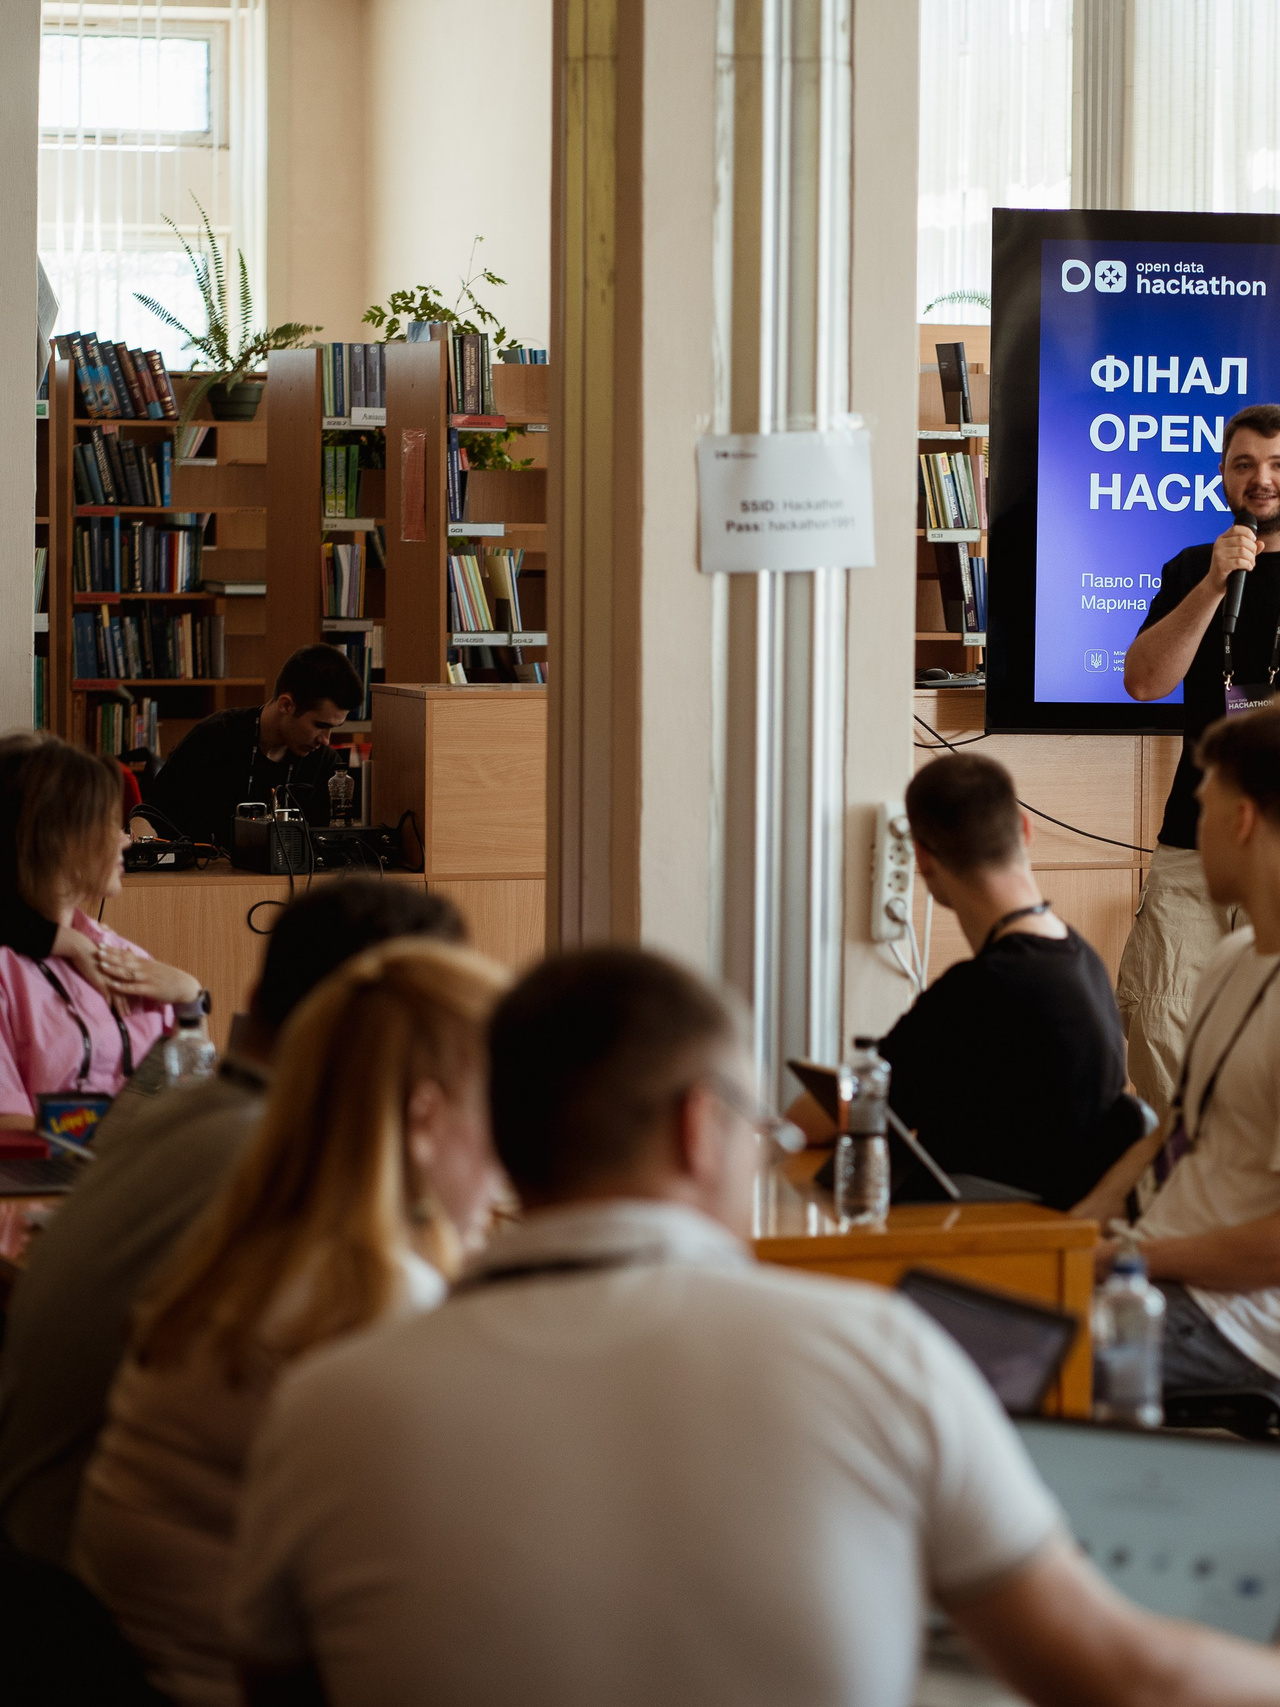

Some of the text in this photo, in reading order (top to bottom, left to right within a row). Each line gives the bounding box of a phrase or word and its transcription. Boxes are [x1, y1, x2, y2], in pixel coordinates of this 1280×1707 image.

[1136, 261, 1204, 274] open data
[1136, 274, 1267, 296] hackathon
[1090, 355, 1248, 395] ФІНАЛ
[1089, 413, 1225, 453] OPEN
[1081, 573, 1134, 588] Павло
[1139, 573, 1162, 589] По
[1081, 595, 1147, 614] Марина
